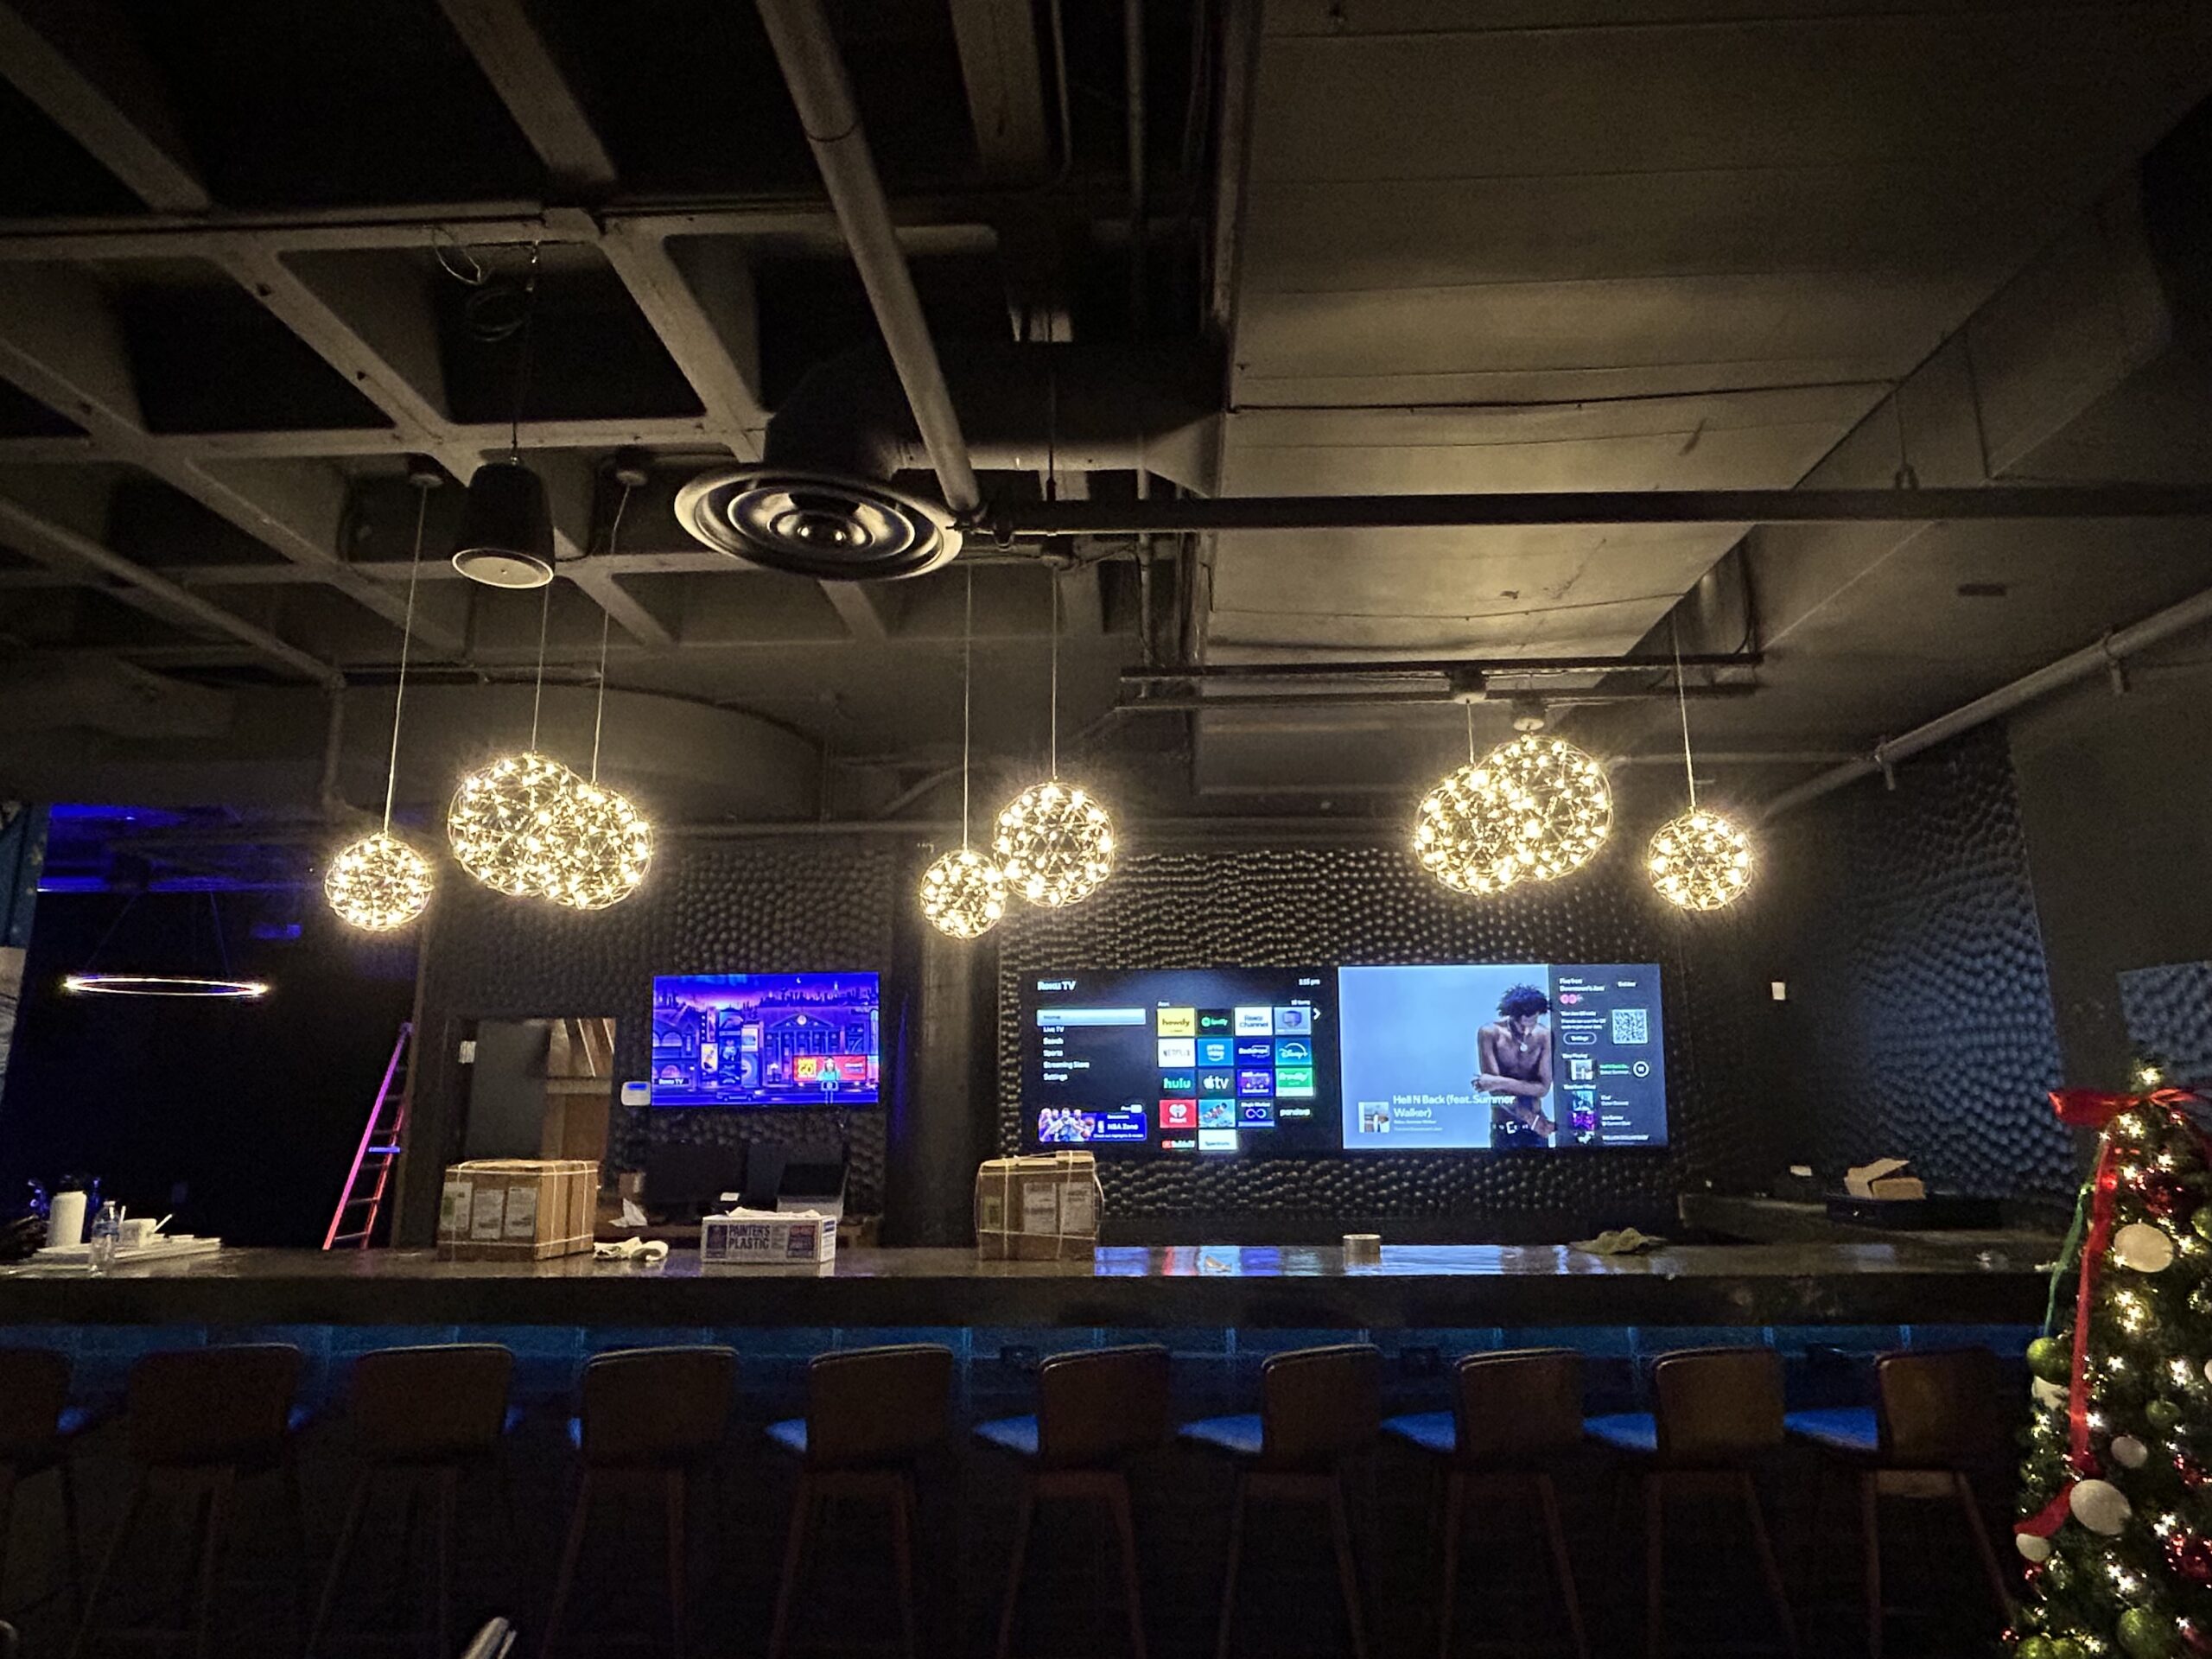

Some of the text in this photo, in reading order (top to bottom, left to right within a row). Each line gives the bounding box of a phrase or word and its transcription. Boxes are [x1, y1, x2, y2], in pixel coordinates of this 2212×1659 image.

[1037, 980, 1077, 991] Roku TV
[1161, 1018, 1191, 1027] howdy
[1163, 1077, 1192, 1089] hulu
[1393, 1095, 1413, 1104] Hell
[1414, 1095, 1421, 1104] N
[1422, 1095, 1446, 1104] Back
[1471, 1094, 1516, 1104] Summer
[1393, 1108, 1433, 1117] Walker)
[728, 1224, 771, 1237] PAINTER'S
[728, 1236, 770, 1249] PLASTIC
